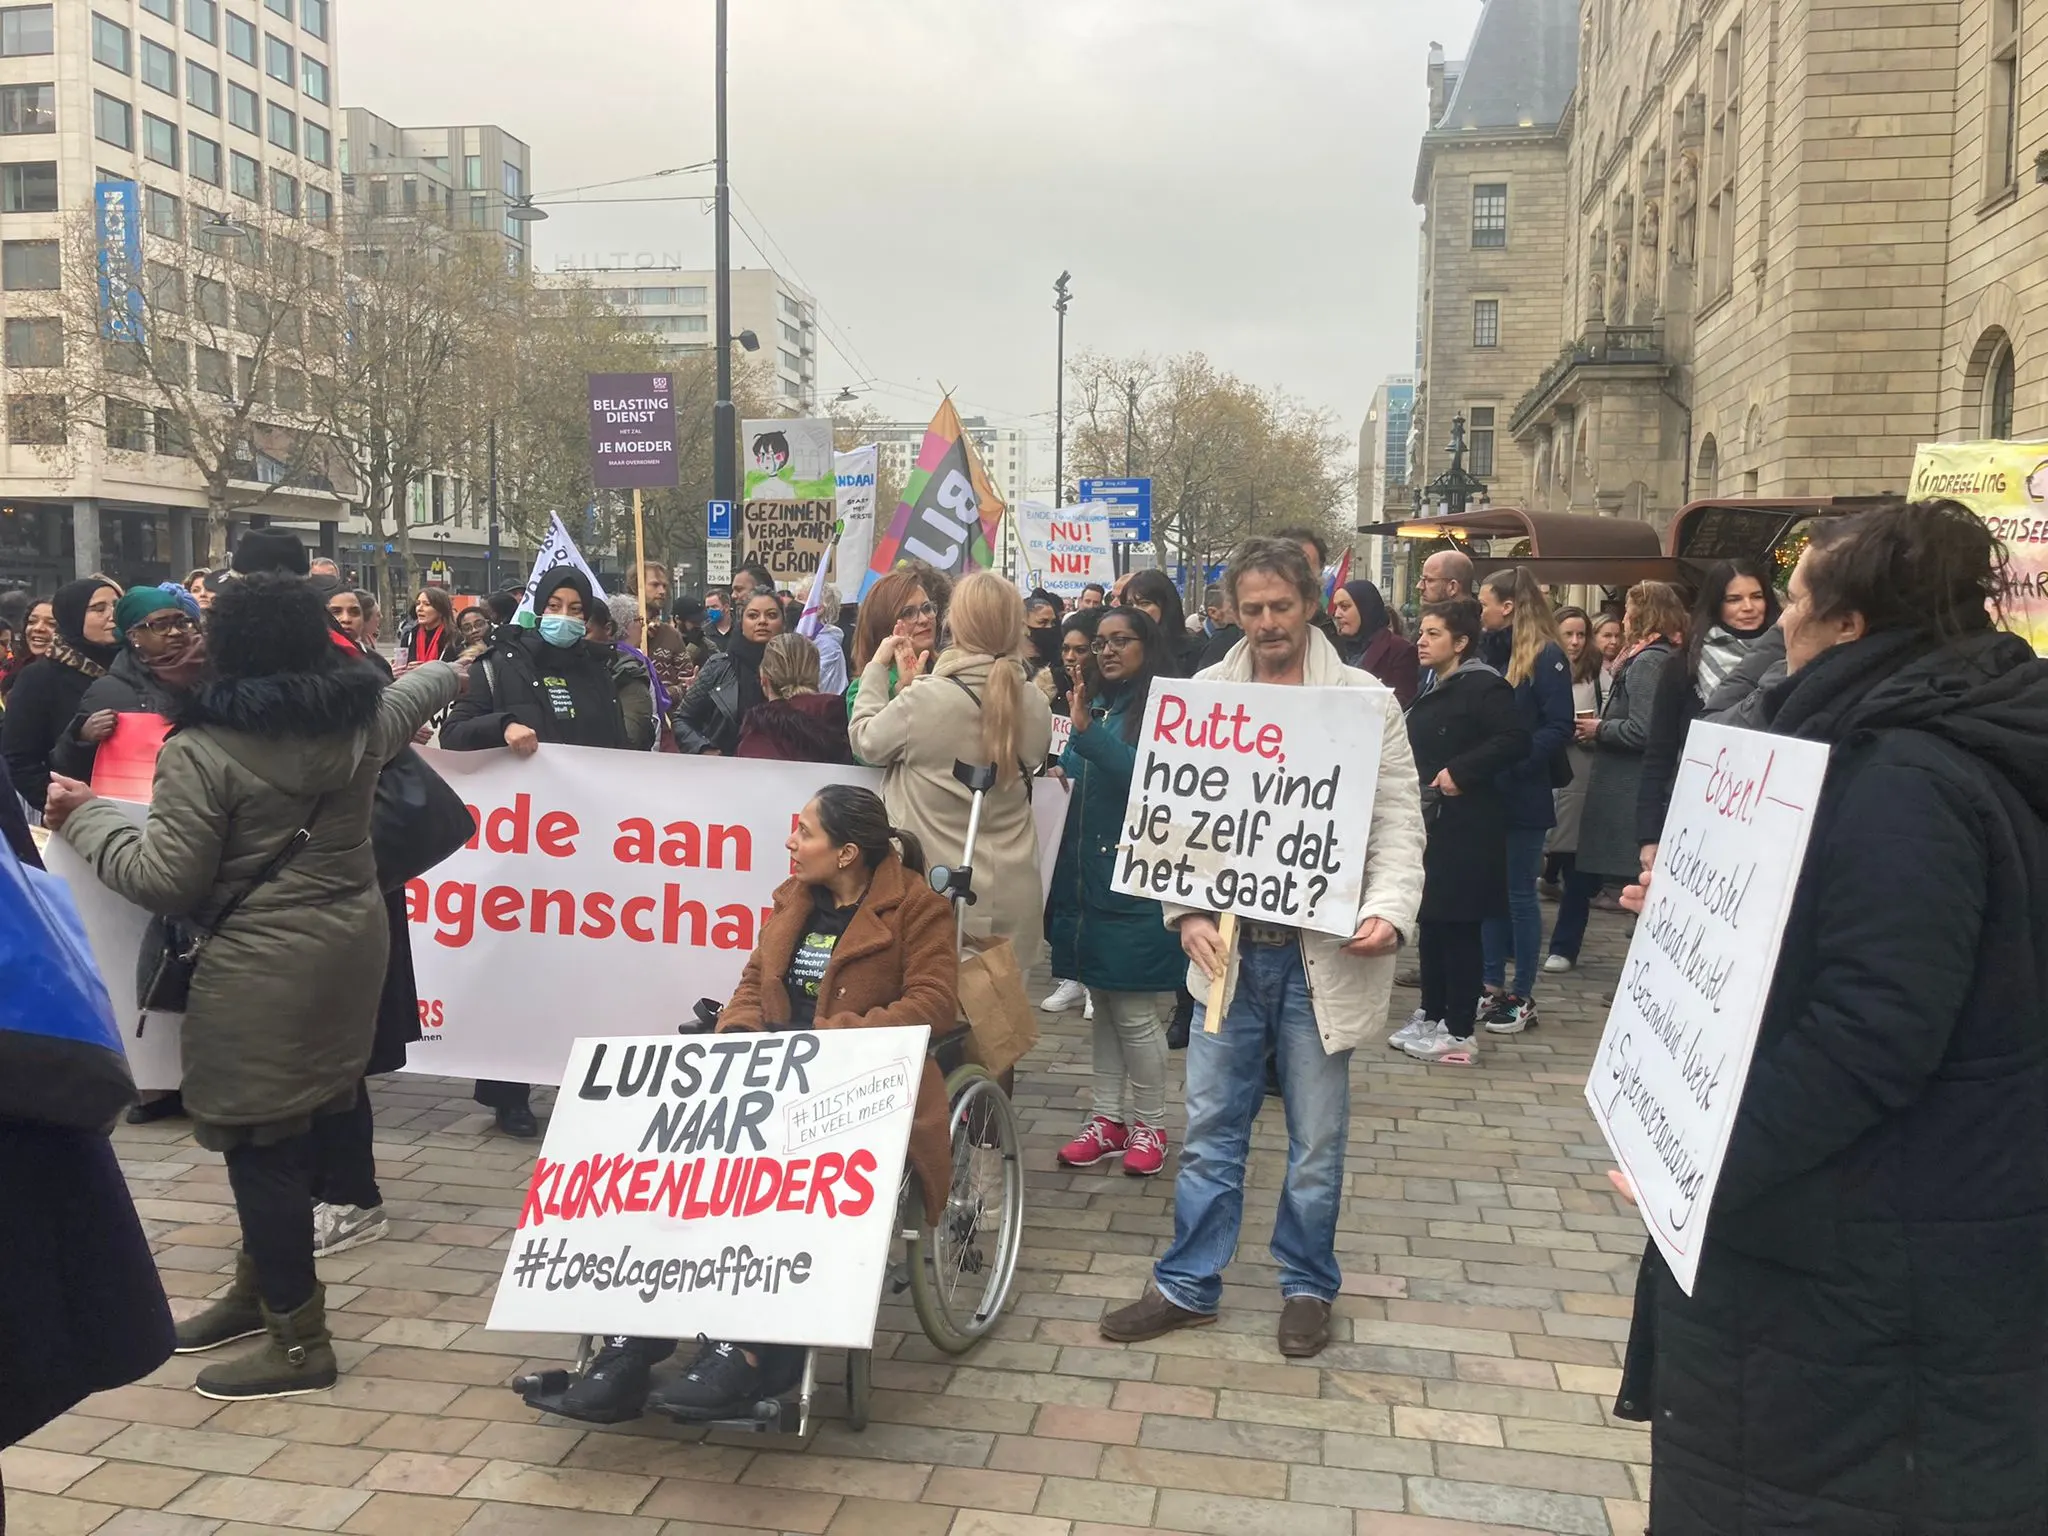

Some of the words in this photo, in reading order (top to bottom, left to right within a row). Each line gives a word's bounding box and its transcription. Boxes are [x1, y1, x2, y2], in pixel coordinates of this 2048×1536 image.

[555, 250, 682, 270] HILTON
[593, 398, 669, 411] BELASTING
[606, 411, 656, 423] DIENST
[597, 442, 612, 454] JE
[614, 440, 672, 453] MOEDER
[713, 503, 726, 523] P
[744, 501, 831, 521] GEZINNEN
[1050, 522, 1091, 542] NU!
[758, 540, 774, 552] IN
[1050, 553, 1091, 575] NU!
[1154, 695, 1286, 763] Rutte,
[1144, 752, 1229, 801] hoe
[1252, 765, 1341, 811] vind
[1705, 747, 1774, 826] Eisen!
[613, 816, 752, 872] aan
[1129, 795, 1171, 845] je
[1185, 809, 1271, 857] zelf
[1277, 820, 1340, 874] dat
[1122, 845, 1195, 896] het
[1206, 856, 1328, 918] gaat?
[578, 1033, 820, 1101] LUISTER
[638, 1091, 774, 1154] NAAR
[800, 1126, 817, 1142] EN
[821, 1112, 854, 1133] VEEL
[517, 1148, 878, 1230] KLOKKENLUIDERS
[513, 1238, 813, 1303] #toeslagenaffaire
